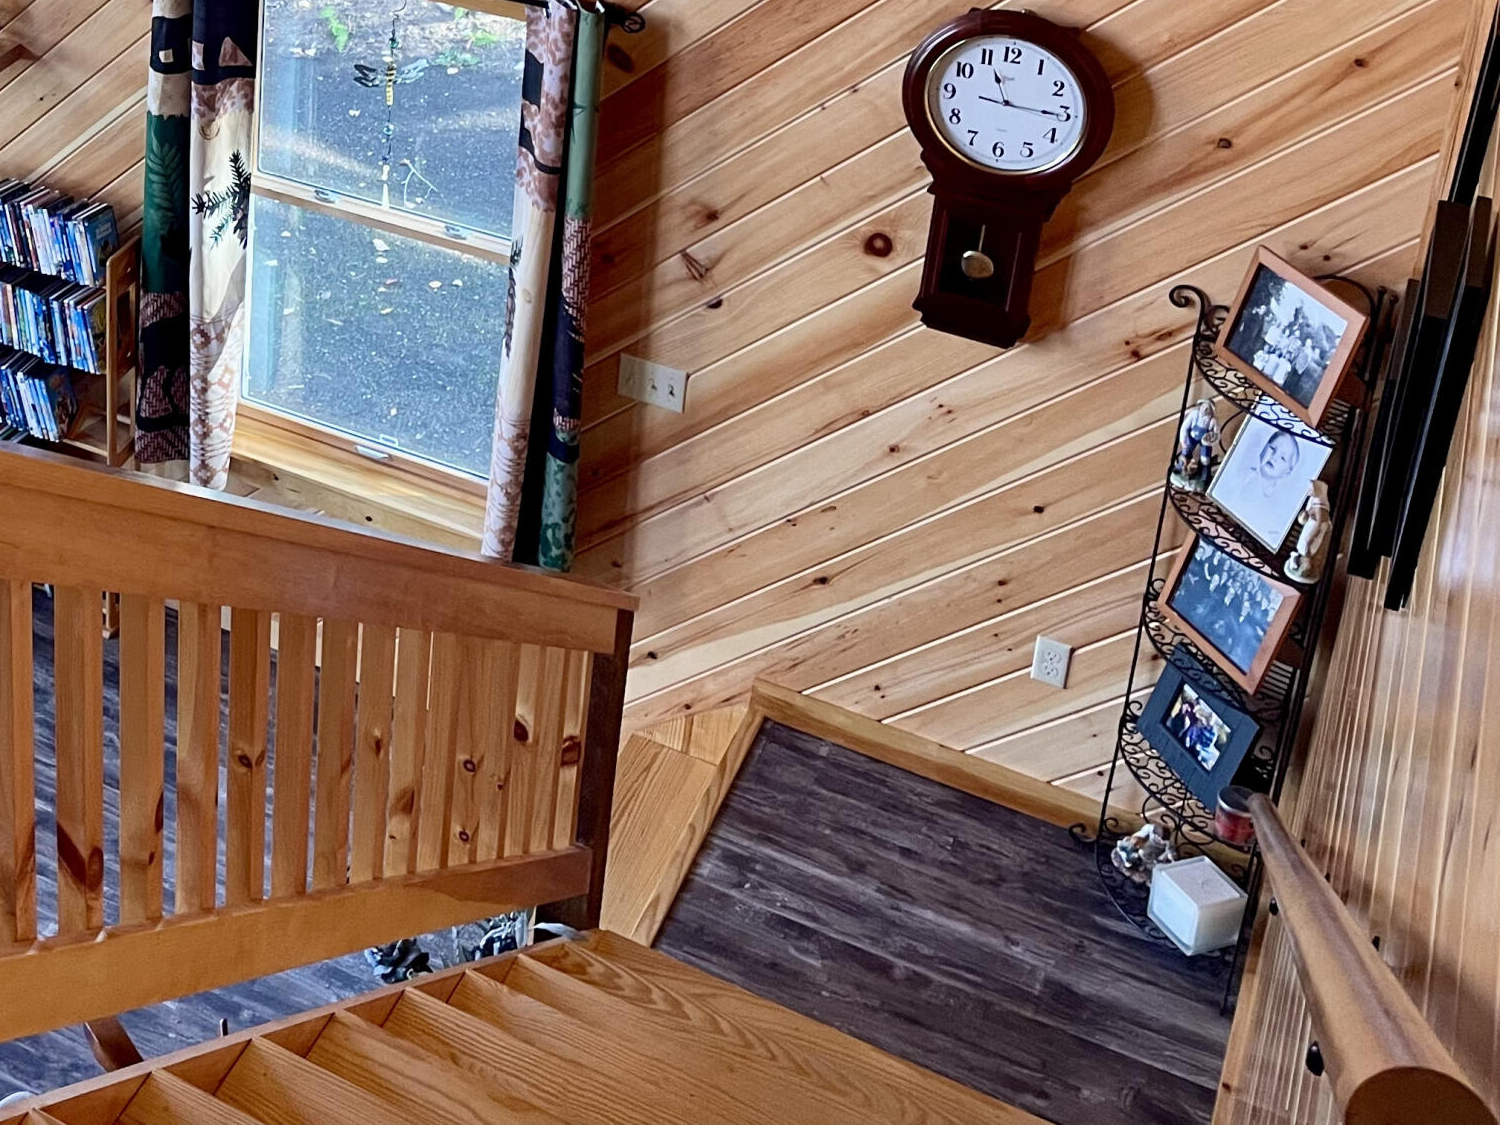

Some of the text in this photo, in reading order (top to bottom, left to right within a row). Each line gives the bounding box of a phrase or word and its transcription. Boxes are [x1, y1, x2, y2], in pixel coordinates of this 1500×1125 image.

[980, 48, 994, 66] 11
[1003, 46, 1023, 65] 12
[956, 61, 974, 79] 10
[1037, 59, 1045, 75] 1
[943, 82, 957, 100] 9
[1052, 80, 1065, 97] 2
[949, 107, 962, 125] 8
[1056, 105, 1071, 122] 3
[967, 129, 979, 146] 7
[1043, 127, 1058, 144] 4
[992, 141, 1005, 158] 6
[1019, 141, 1034, 158] 5
